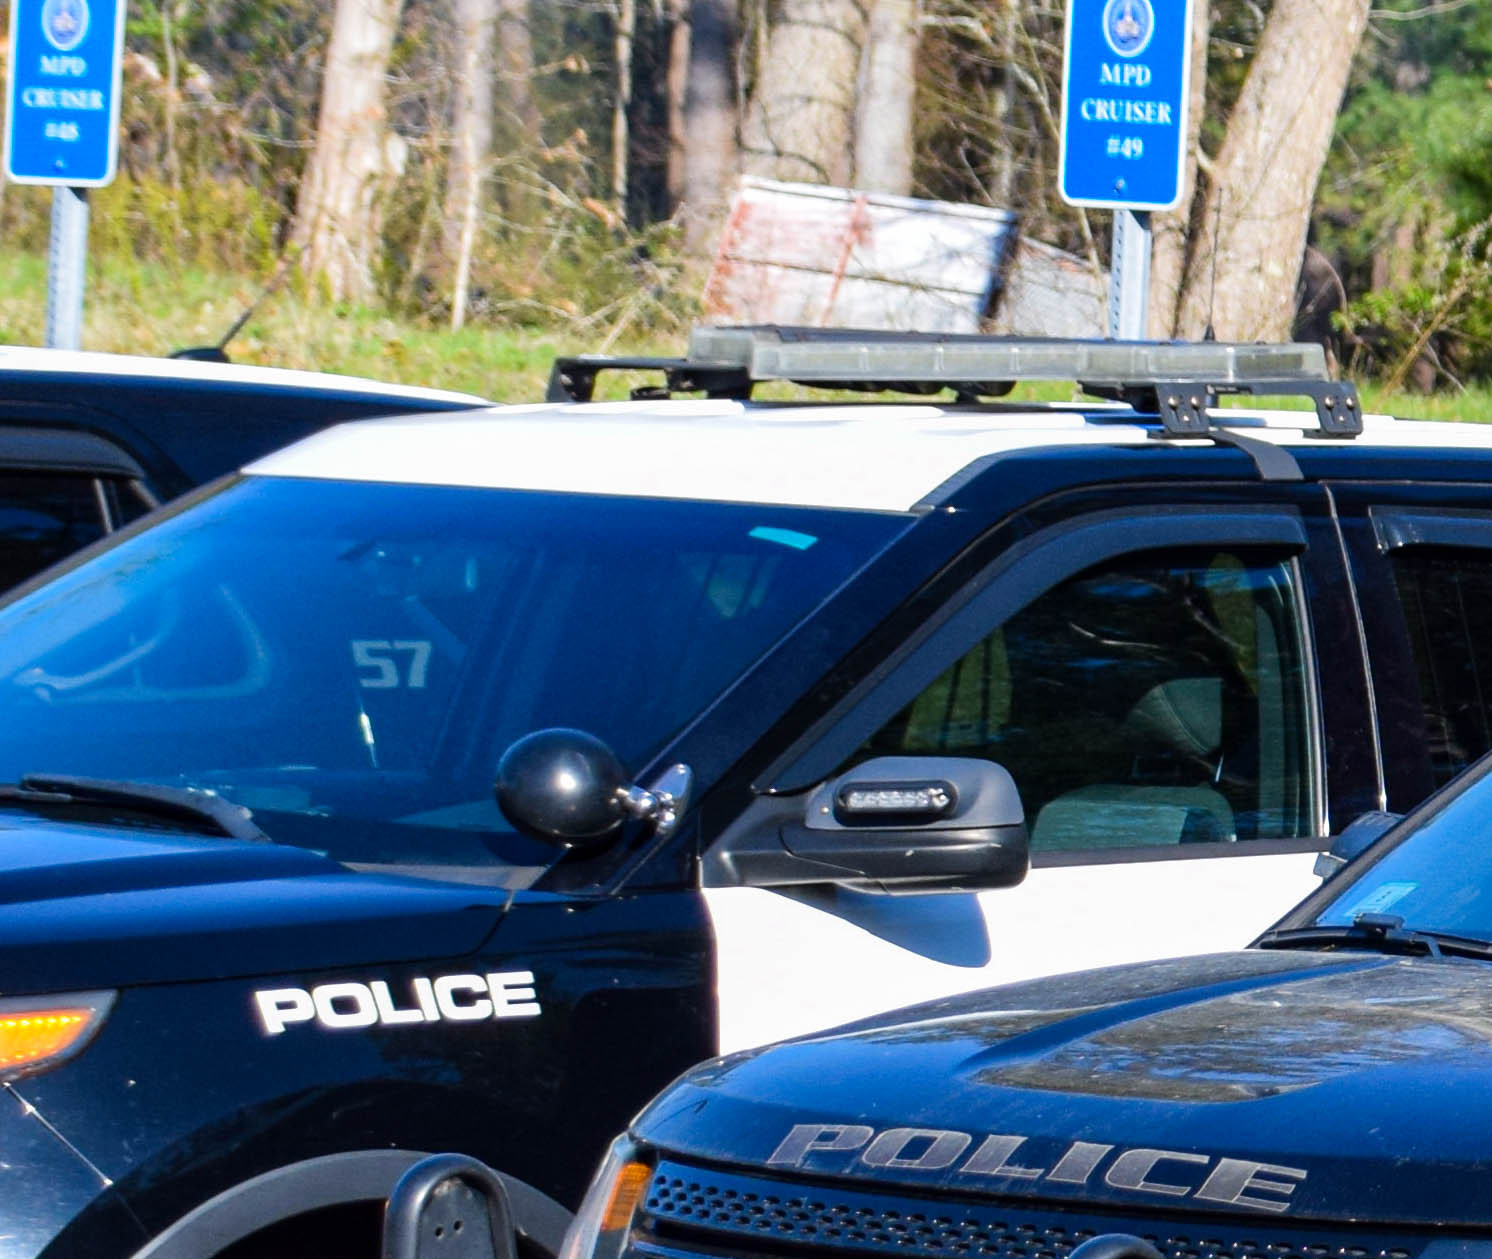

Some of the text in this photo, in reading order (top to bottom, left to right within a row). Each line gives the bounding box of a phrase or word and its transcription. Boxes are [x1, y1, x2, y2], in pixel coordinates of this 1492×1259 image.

[40, 55, 87, 76] MPD
[1101, 62, 1152, 86] MPD
[1081, 97, 1171, 124] CRUISER
[1106, 133, 1144, 158] #49
[350, 640, 432, 688] 57
[254, 970, 541, 1035] POLICE
[767, 1124, 1307, 1211] POLICE
